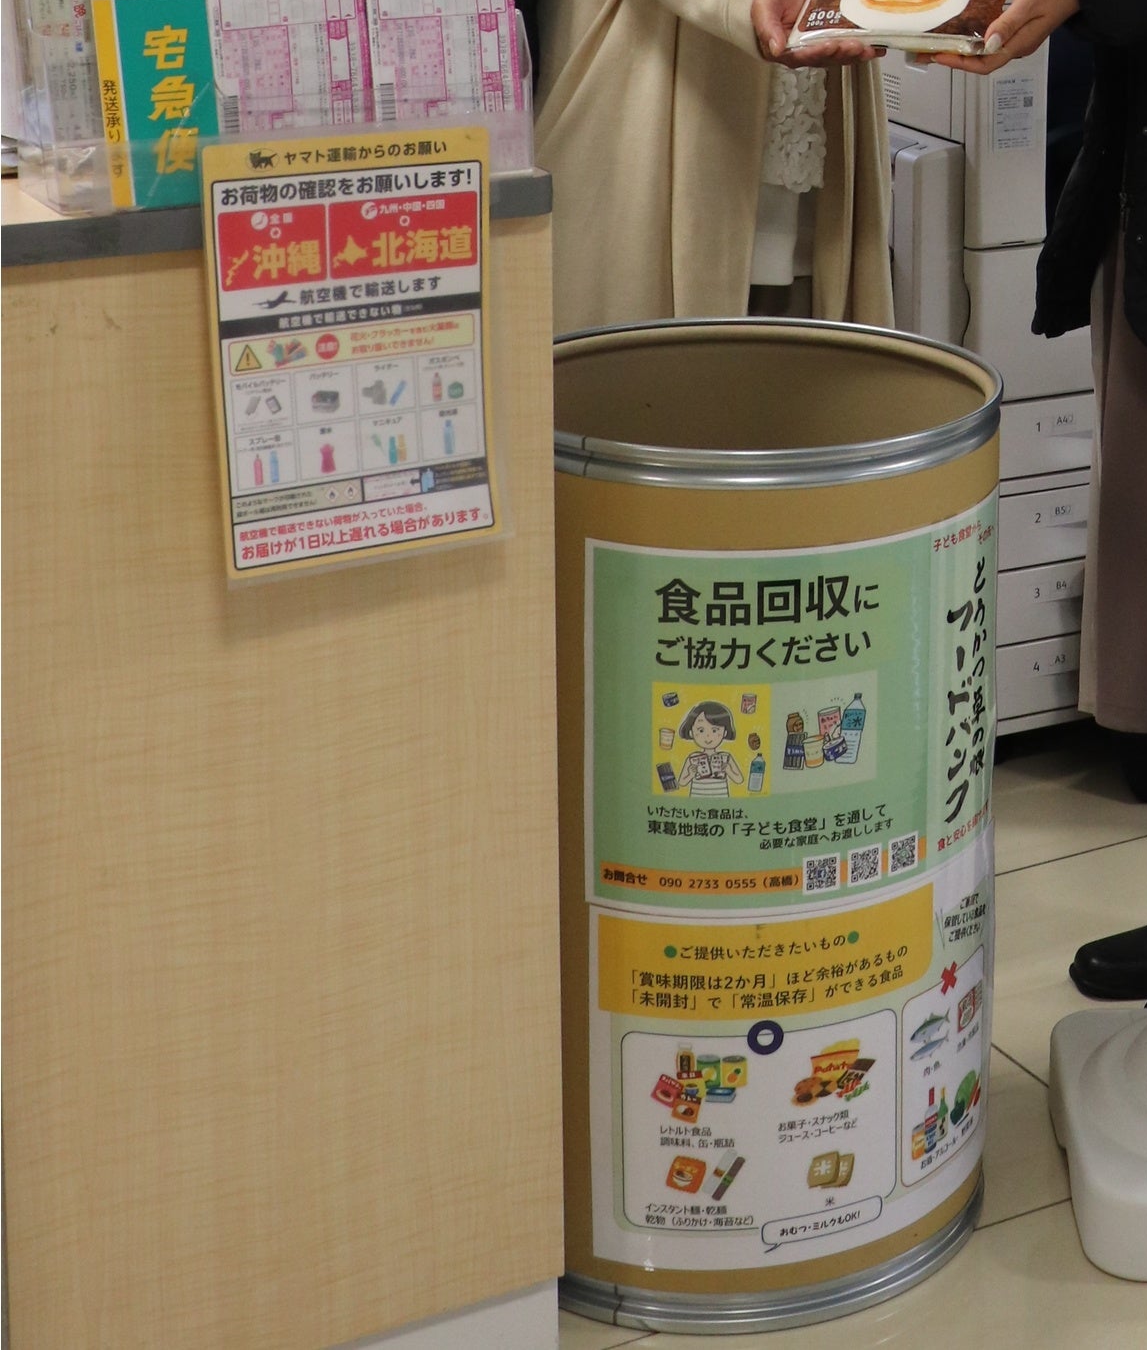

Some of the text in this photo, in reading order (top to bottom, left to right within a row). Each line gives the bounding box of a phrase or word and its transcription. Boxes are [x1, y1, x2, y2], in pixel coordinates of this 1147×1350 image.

[143, 25, 199, 175] 宅急便
[284, 141, 447, 166] ヤマト運輸からのお願い
[221, 168, 472, 207] お荷物の確認をお願いします!
[379, 200, 446, 215] 九州・中国・四国
[372, 225, 473, 268] 北海道
[253, 240, 322, 280] 沖縄
[300, 275, 441, 306] 航空機で輸送します
[1056, 416, 1068, 425] A4
[1035, 513, 1041, 523] 2
[1055, 506, 1066, 515] B5
[241, 507, 489, 560] お届けが1日以上遅れる場合があります。
[1034, 588, 1040, 598] 3
[1056, 581, 1067, 590] B4
[654, 575, 881, 627] 食品回収に
[654, 629, 872, 671] ご協力ください
[1054, 654, 1066, 664] A3
[1033, 662, 1040, 671] 4
[945, 600, 973, 823] フードバンク
[647, 806, 749, 820] いただいた食品は、
[759, 817, 894, 850] 必要な家庭へお渡しします
[603, 867, 648, 886] お問合せ
[659, 877, 682, 889] 090
[689, 878, 719, 890] 2733
[725, 877, 757, 889] 0555
[660, 1126, 712, 1137] レトルト食品
[778, 1110, 849, 1132] お菓子・スナック類
[778, 1118, 858, 1144] ジュース・コーヒーなど
[825, 1196, 835, 1207] 米
